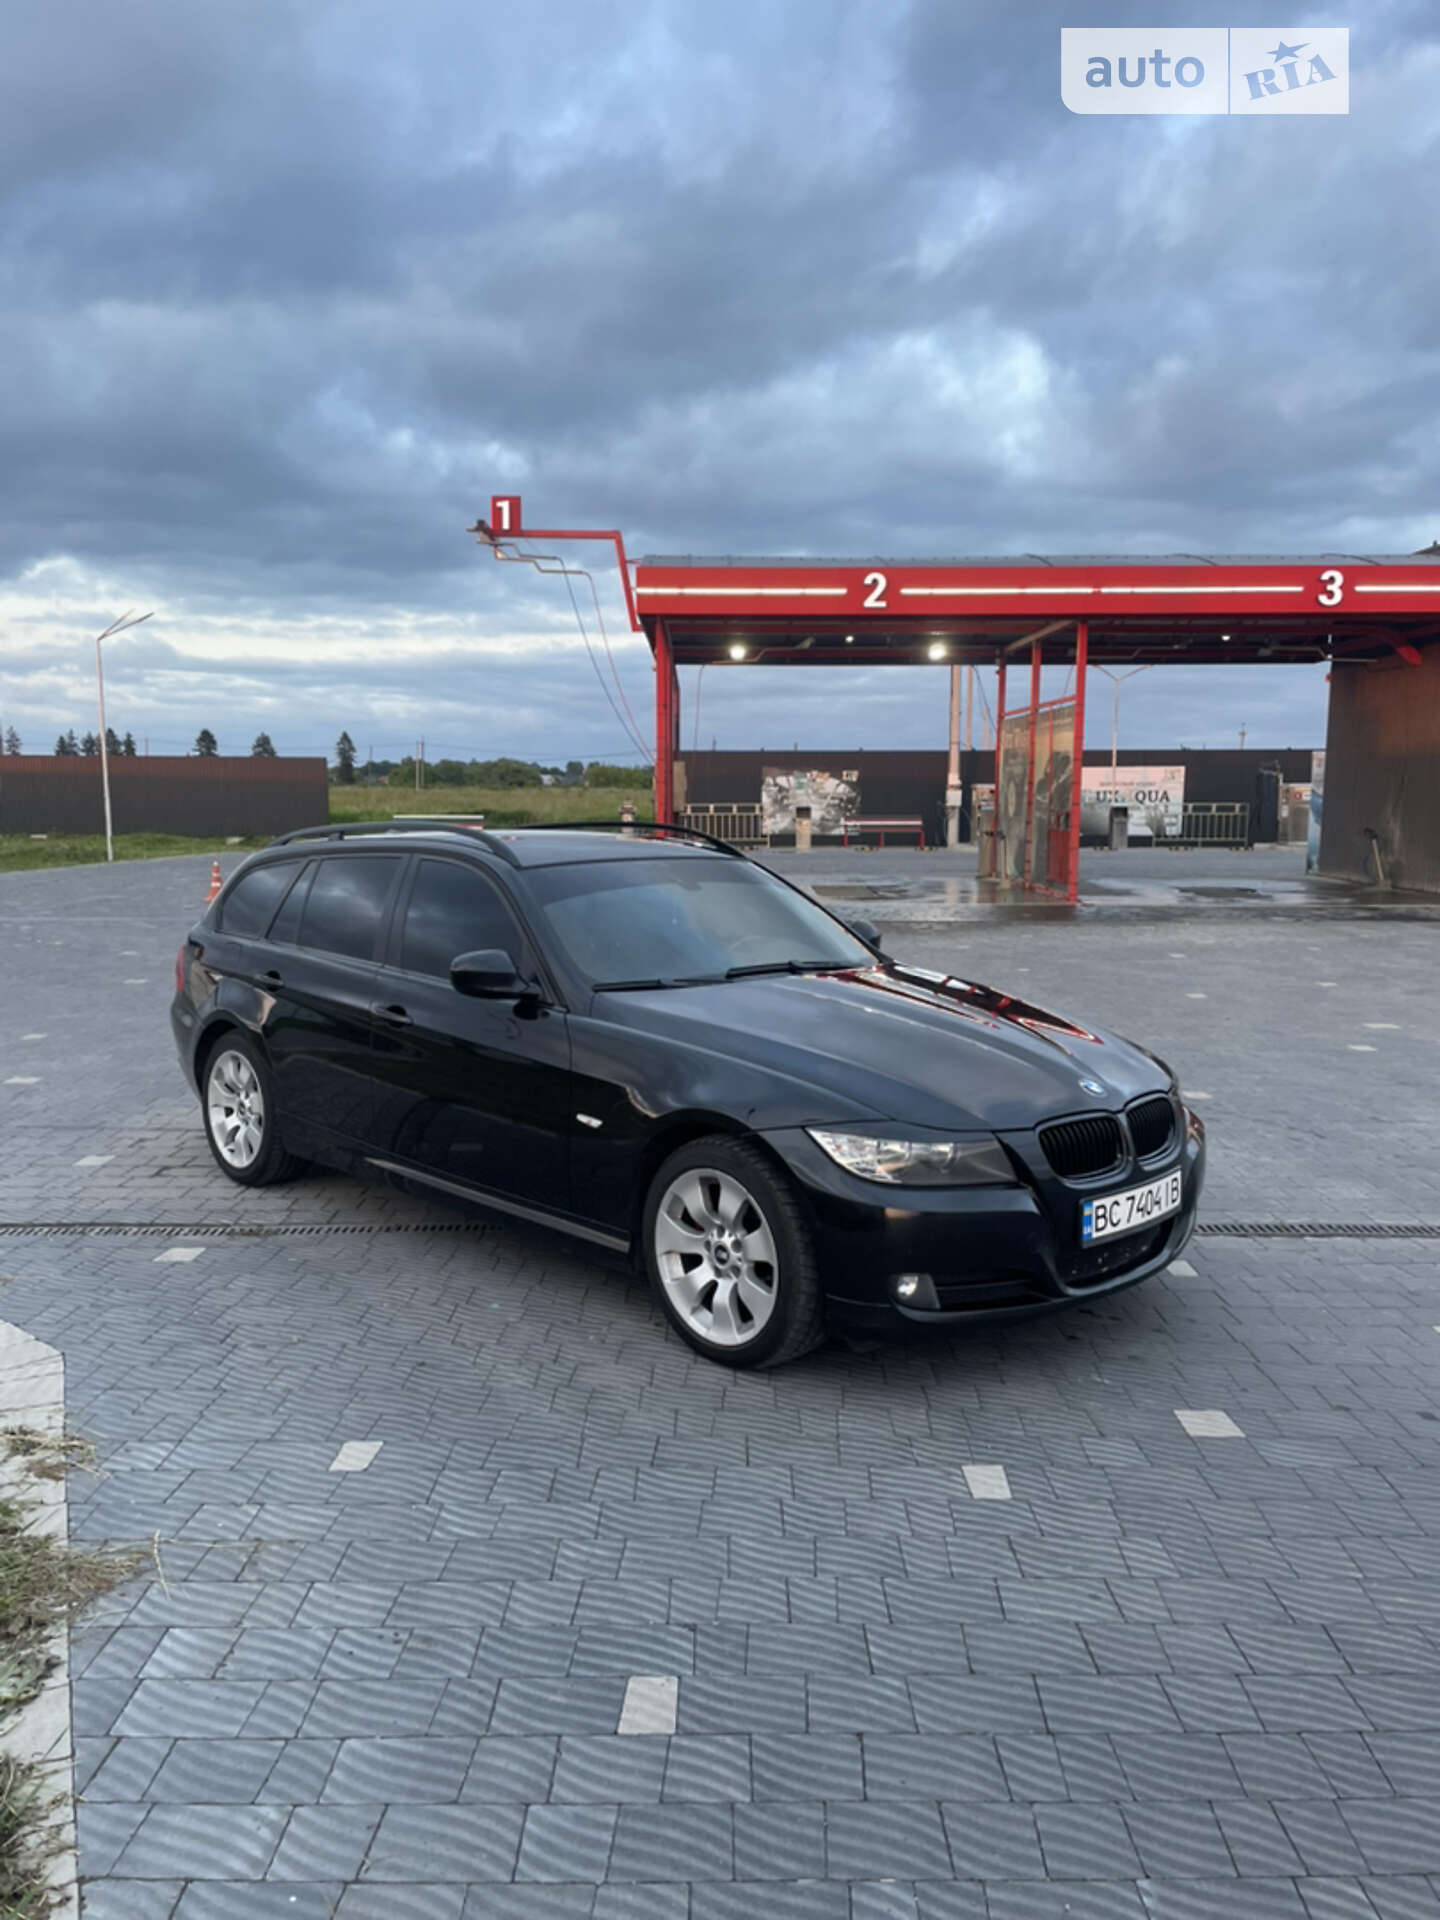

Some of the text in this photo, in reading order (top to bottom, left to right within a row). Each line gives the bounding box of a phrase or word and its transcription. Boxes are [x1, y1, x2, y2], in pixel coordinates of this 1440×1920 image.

[496, 500, 510, 530] 1
[863, 571, 887, 608] 2
[1318, 569, 1344, 608] 3
[1095, 1200, 1121, 1233] BC
[1126, 1186, 1162, 1223] 7404
